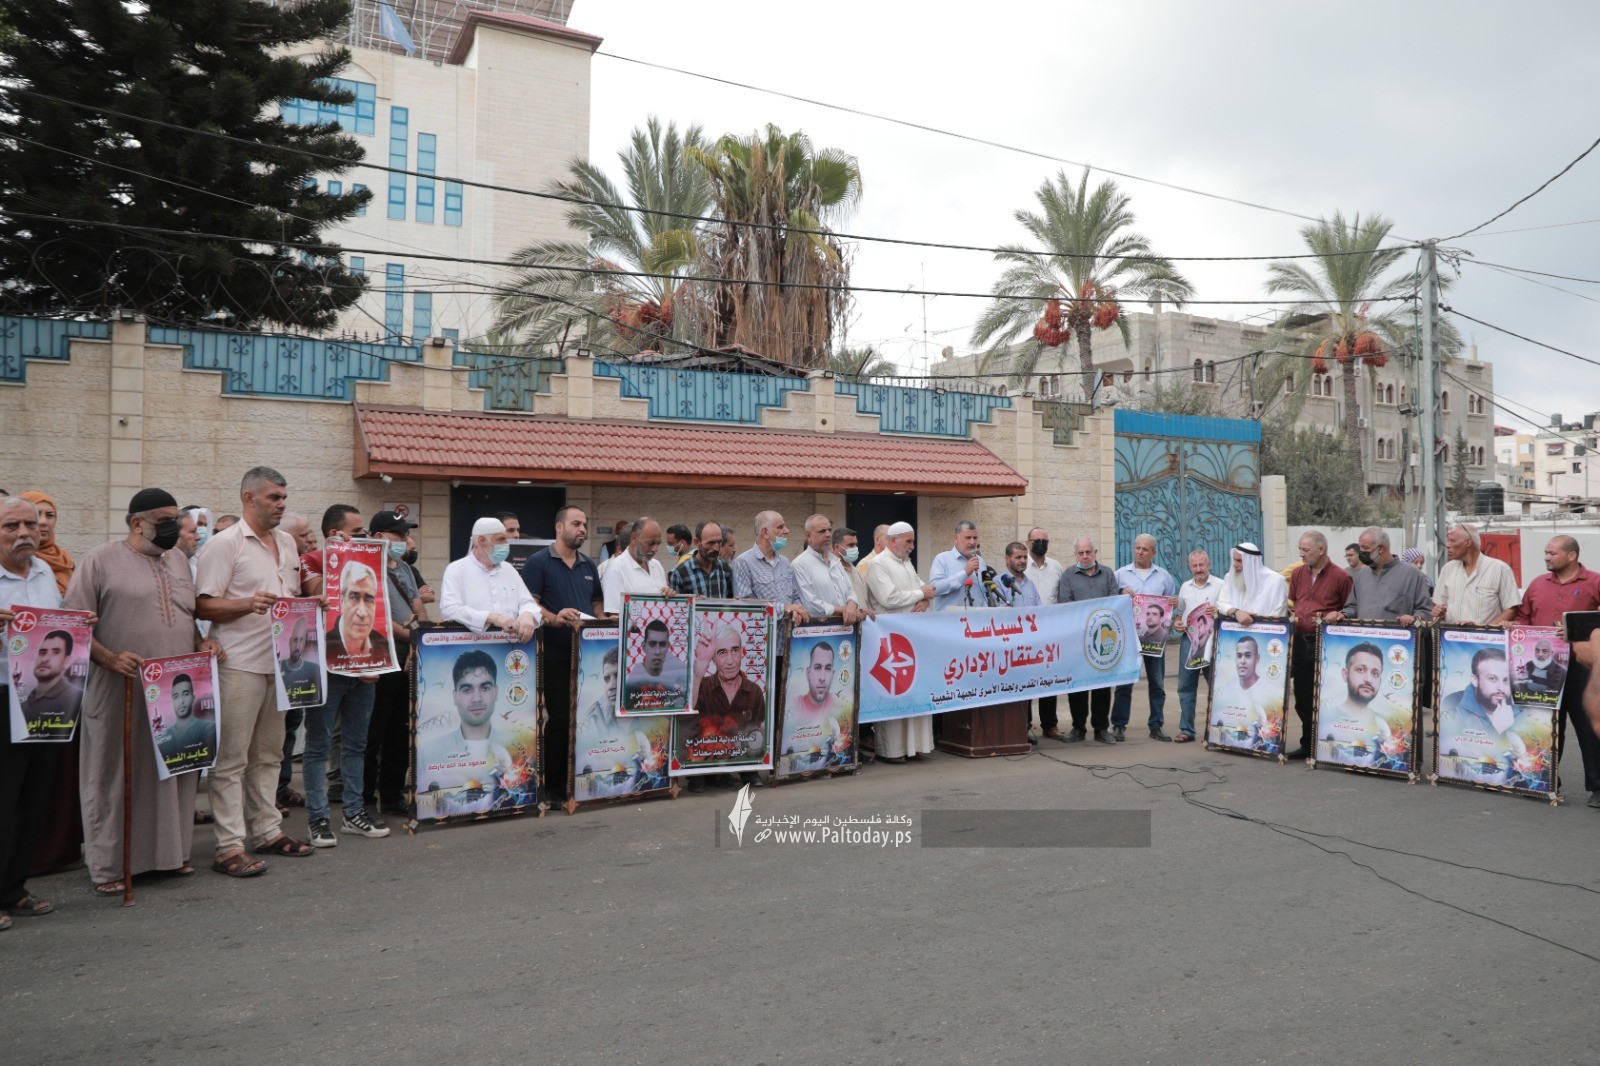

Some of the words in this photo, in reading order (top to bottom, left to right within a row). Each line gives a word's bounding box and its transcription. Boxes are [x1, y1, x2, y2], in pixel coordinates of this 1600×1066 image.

[960, 614, 1023, 642] لسياسة
[1026, 613, 1038, 632] لا
[998, 643, 1060, 676] الإعتقال
[943, 651, 996, 685] الإداري
[1019, 678, 1039, 693] القدس
[1040, 677, 1053, 691] مهجة
[1054, 674, 1073, 685] مؤسسة
[291, 683, 316, 699] شادي
[957, 687, 977, 701] للجبهة
[1000, 682, 1019, 696] ولجنة
[930, 690, 956, 705] الشعبية
[1514, 691, 1542, 703] بشارات
[41, 716, 75, 731] هشام
[685, 737, 693, 747] مع
[693, 735, 718, 747] للتضامن
[719, 735, 738, 745] الدولية
[187, 746, 208, 761] كايد
[693, 748, 712, 757] سعدات
[469, 760, 487, 768] محمود
